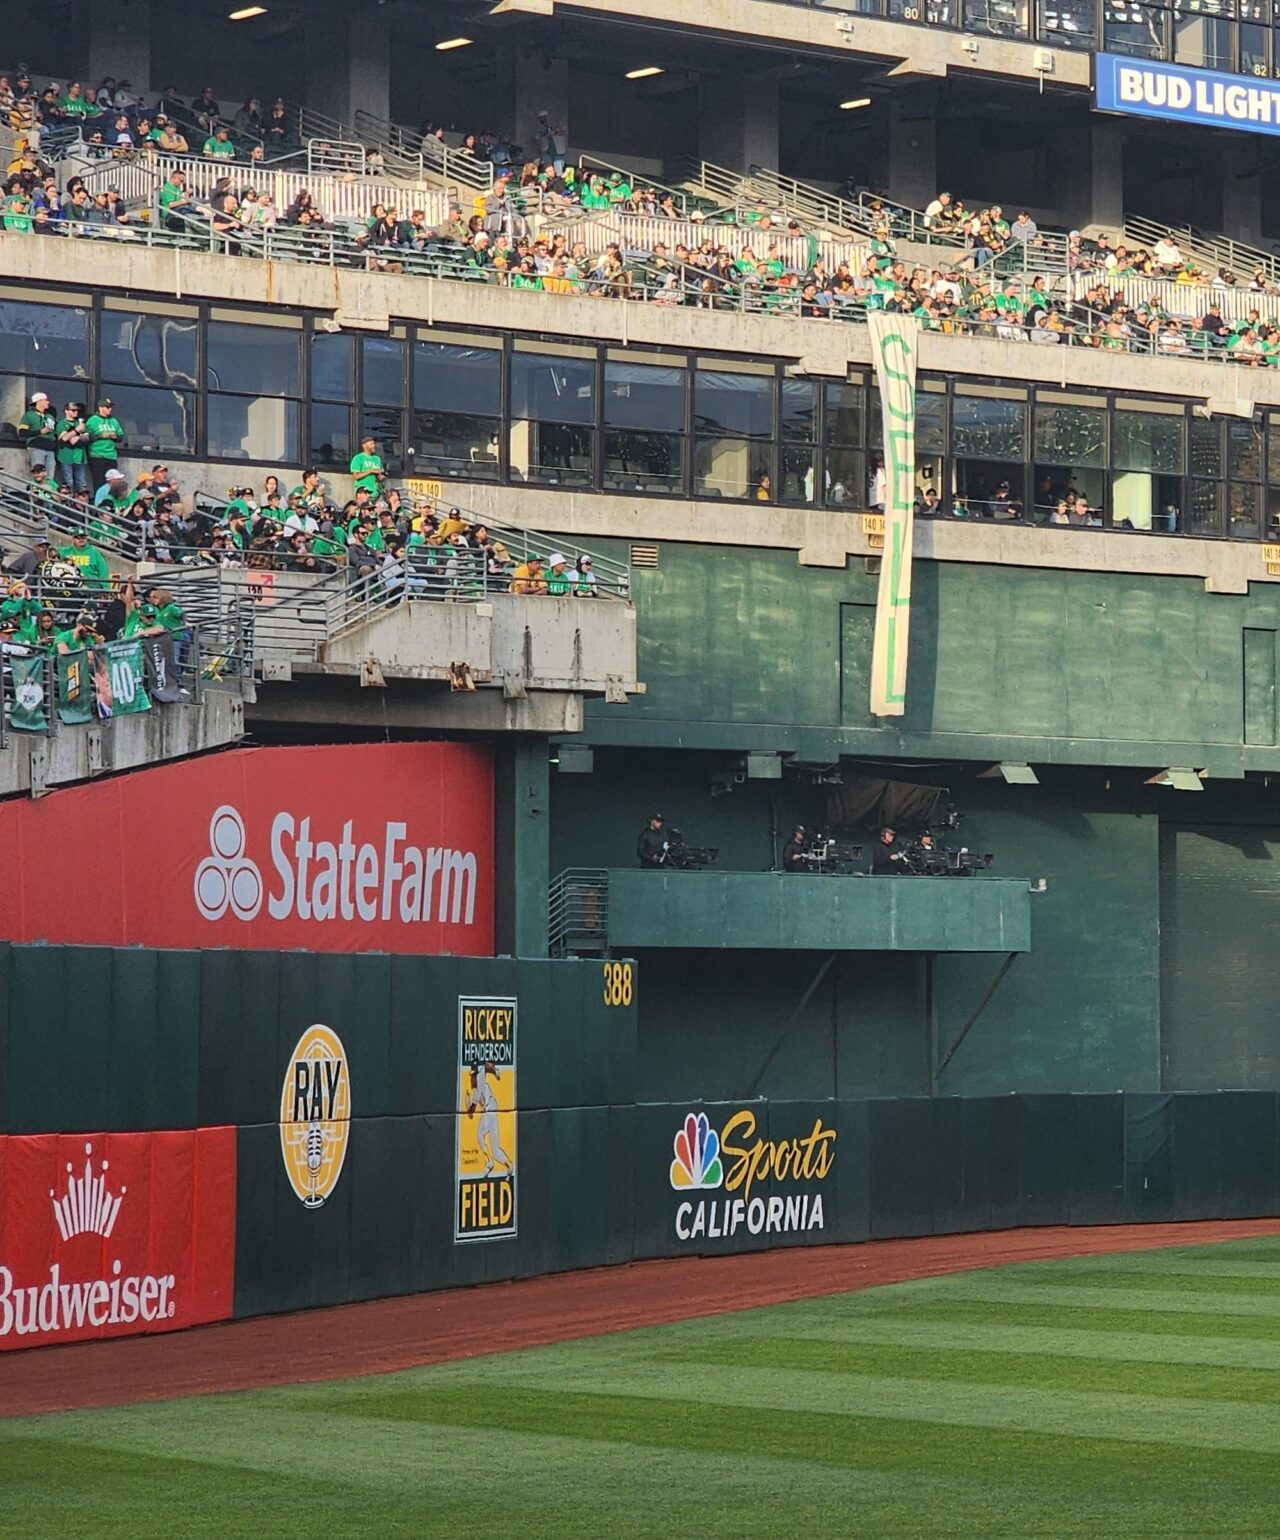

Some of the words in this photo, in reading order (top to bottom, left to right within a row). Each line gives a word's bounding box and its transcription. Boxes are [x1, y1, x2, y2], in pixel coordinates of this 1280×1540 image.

[904, 6, 918, 20] 80
[1120, 68, 1193, 109] BUD
[1254, 65, 1267, 77] 82
[426, 484, 439, 497] 140
[865, 518, 876, 531] 140
[879, 334, 916, 704] SELL
[1264, 547, 1273, 560] 141
[603, 963, 632, 1006] 388
[465, 1009, 512, 1040] RICKEY
[464, 1043, 512, 1061] HENDERSON
[293, 1061, 342, 1121] RAY
[721, 1110, 837, 1206] Sports
[461, 1181, 513, 1228] FIELD
[676, 1194, 824, 1240] CALIFORNIA
